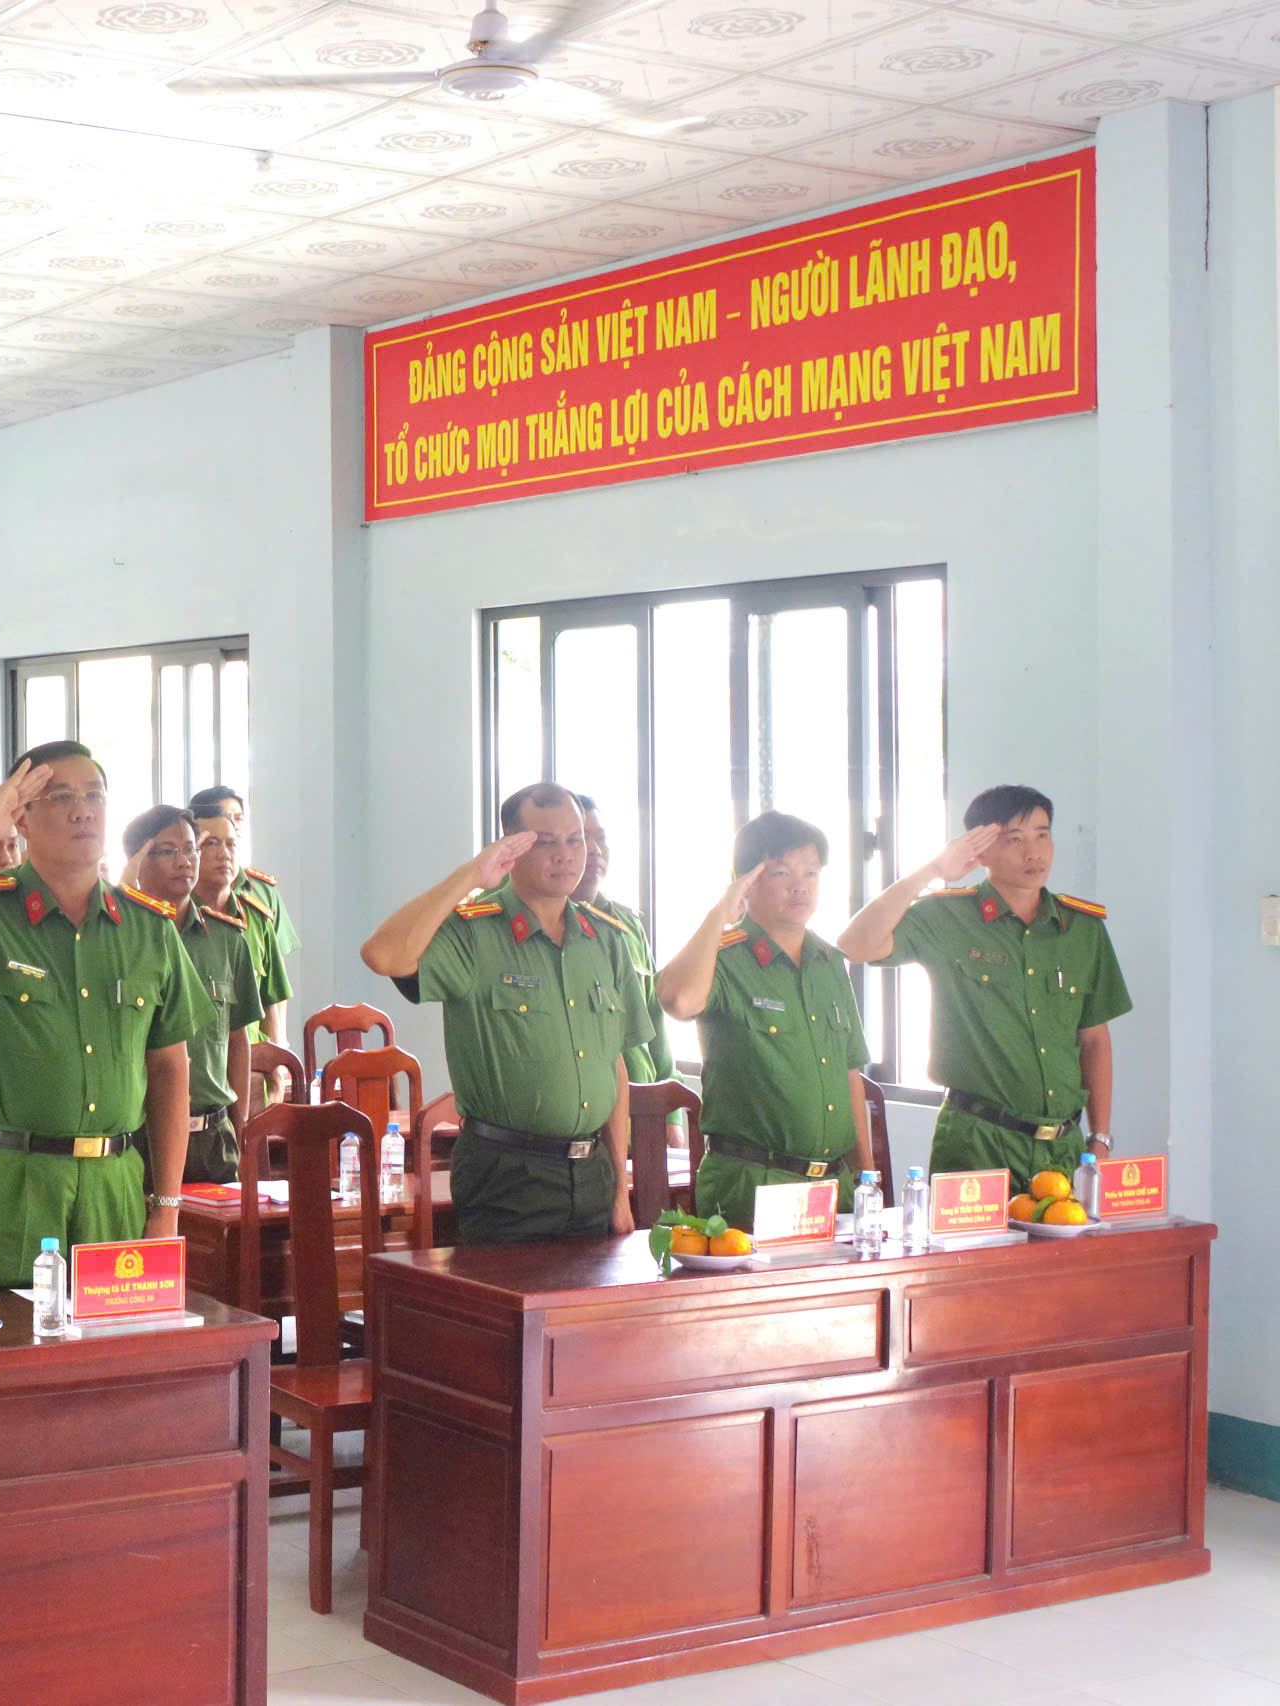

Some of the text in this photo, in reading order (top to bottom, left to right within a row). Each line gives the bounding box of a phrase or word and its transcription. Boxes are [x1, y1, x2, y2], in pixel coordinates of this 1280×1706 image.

[384, 312, 1060, 486] TỔ CHỨC MỌI THẮNG LỢI CỦA CÁCH MẠNG VIỆT NAM
[409, 340, 466, 404] ĐẢNG
[473, 330, 533, 396] CỘNG
[541, 308, 588, 375] SẢN
[596, 299, 648, 369] VIỆT
[656, 288, 716, 350] NAM
[751, 250, 838, 330] NGƯỜI
[850, 238, 930, 309] LÃNH
[941, 221, 1016, 296] ĐẠO,
